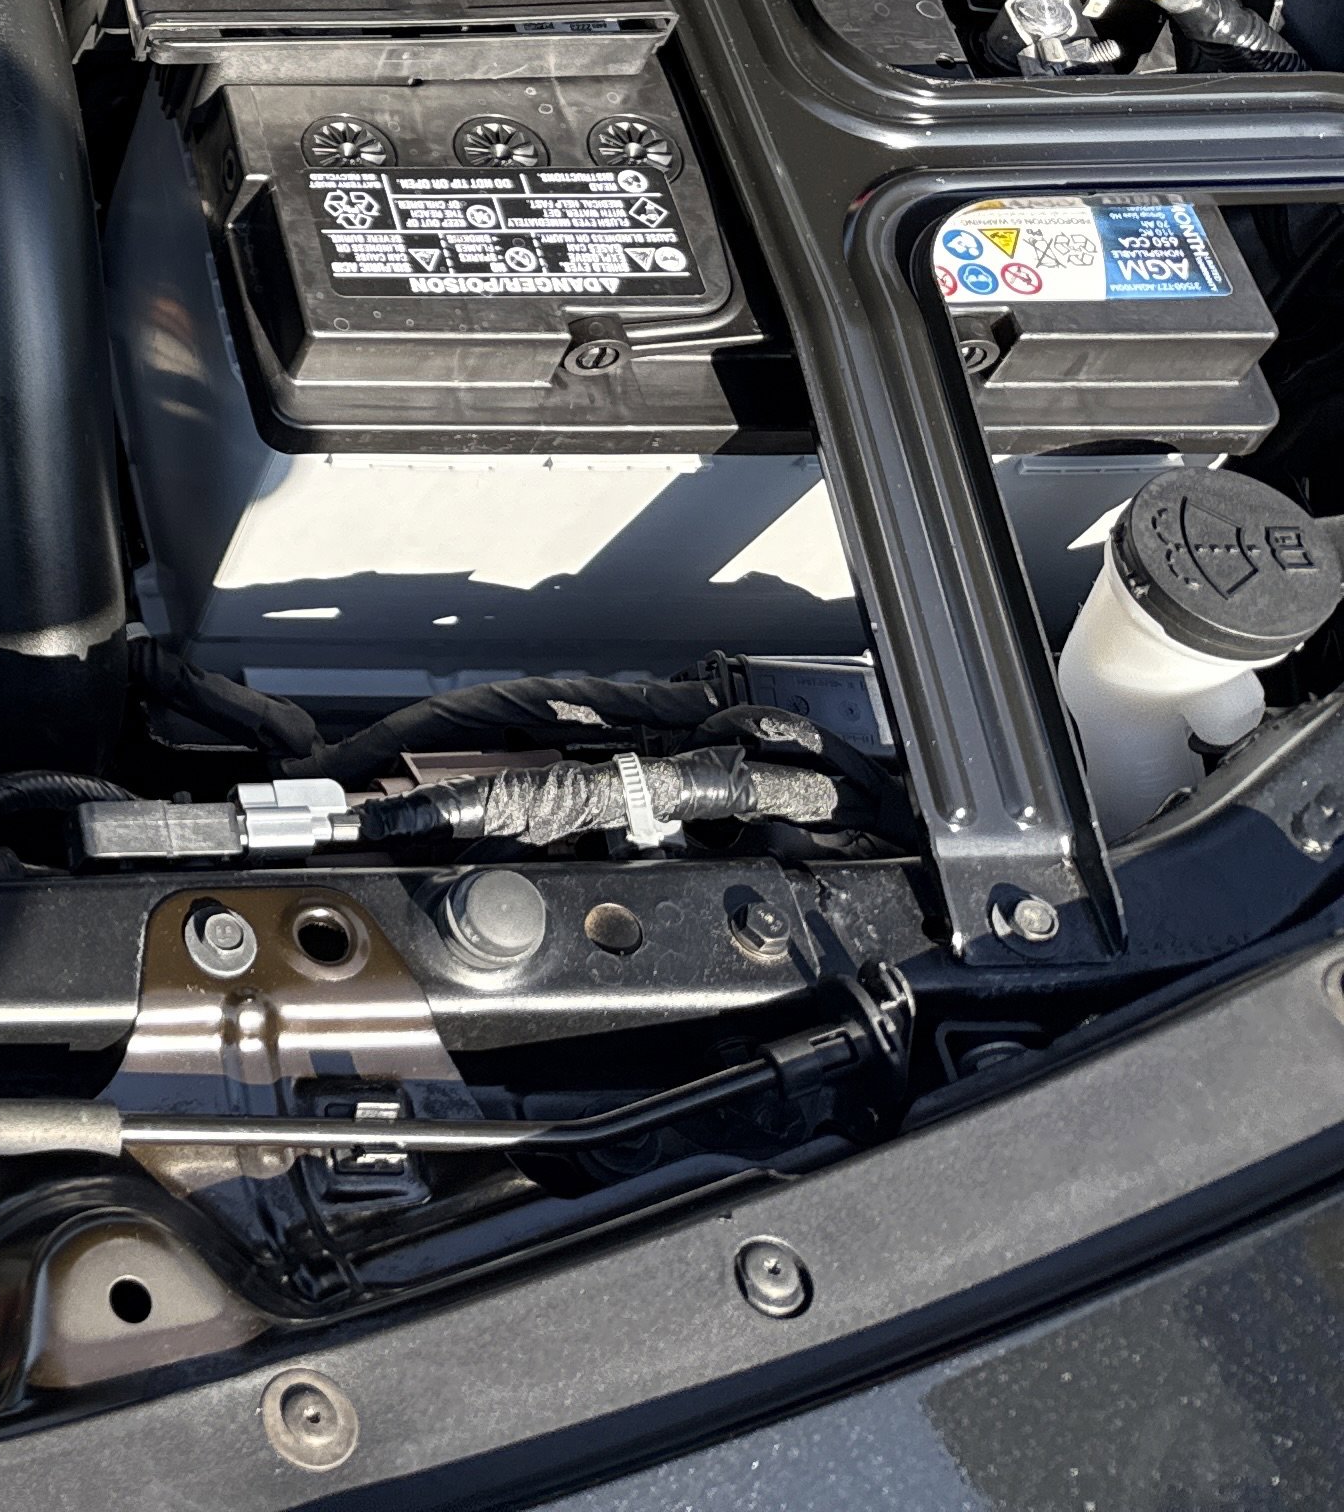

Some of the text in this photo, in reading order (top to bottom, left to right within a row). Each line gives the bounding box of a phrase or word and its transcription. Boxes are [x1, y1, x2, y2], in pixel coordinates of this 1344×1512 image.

[1118, 237, 1178, 247] 650 CCA
[1111, 250, 1184, 258] NONSPILLABLE
[1117, 259, 1189, 280] AGM
